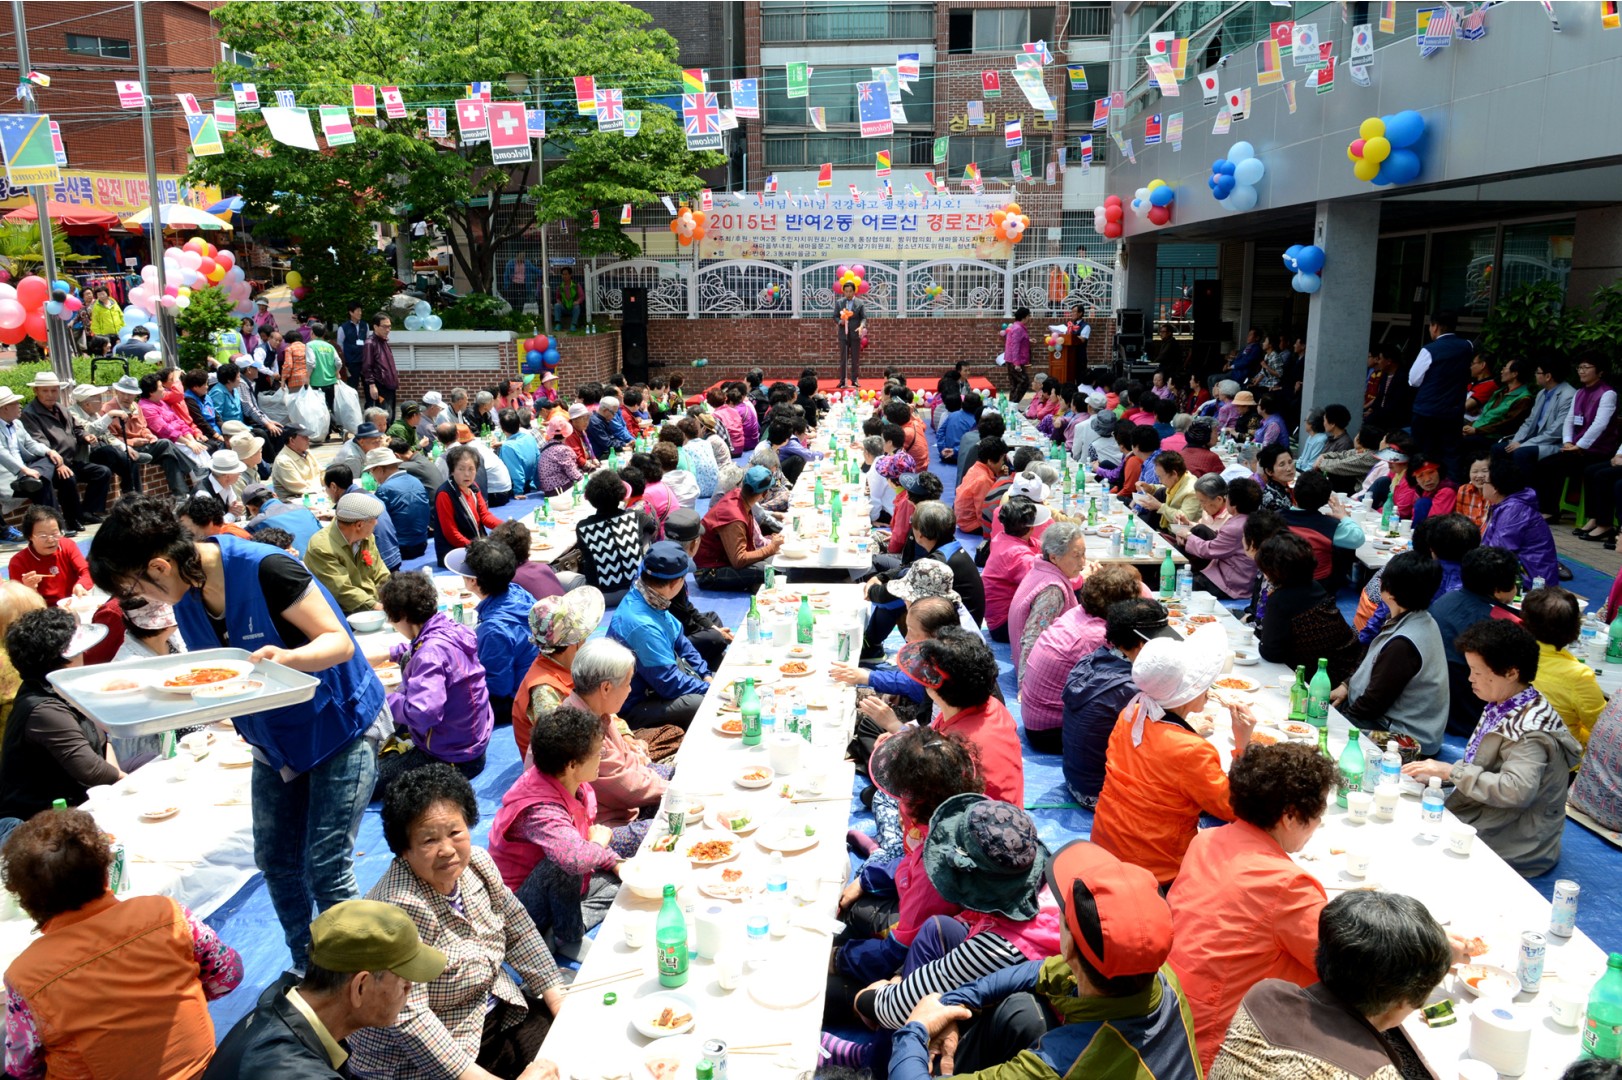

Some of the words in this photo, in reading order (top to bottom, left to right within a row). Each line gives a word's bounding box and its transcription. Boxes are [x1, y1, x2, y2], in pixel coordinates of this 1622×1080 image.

[97, 178, 124, 206] 완전
[832, 199, 878, 210] 건강하고
[710, 213, 777, 231] 2015년
[786, 213, 853, 232] 반여2동
[861, 213, 917, 231] 어르신
